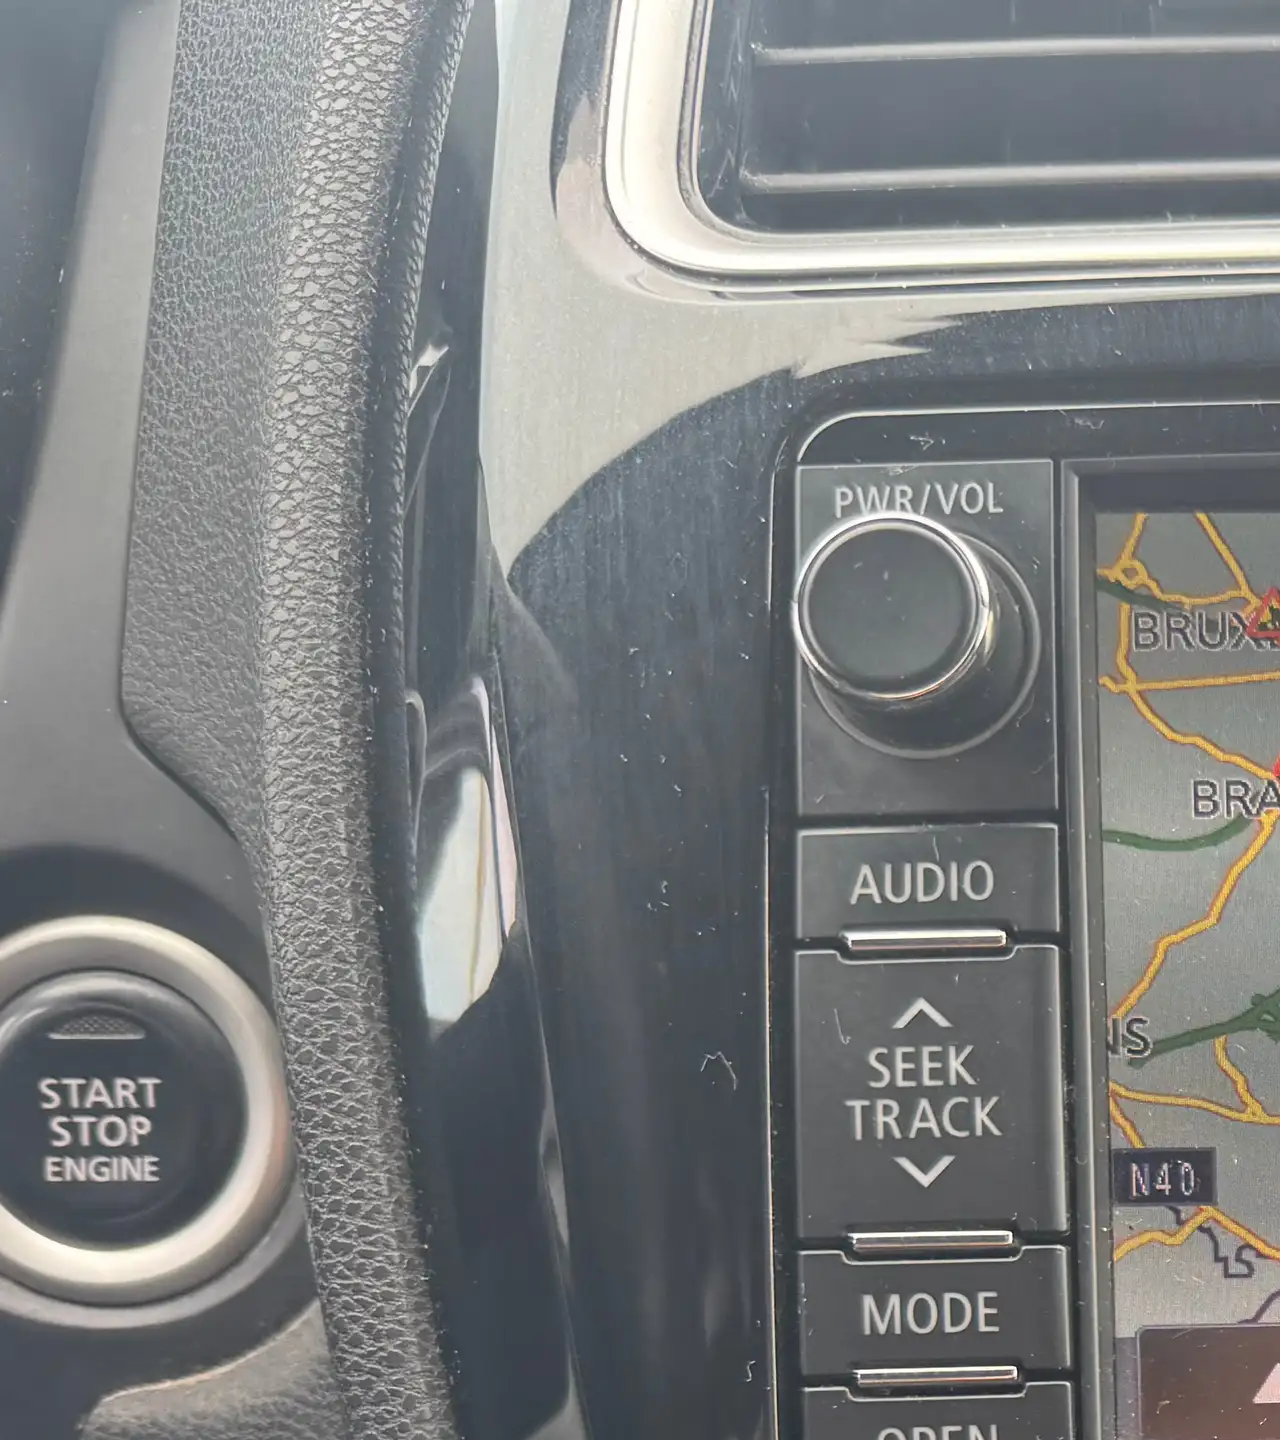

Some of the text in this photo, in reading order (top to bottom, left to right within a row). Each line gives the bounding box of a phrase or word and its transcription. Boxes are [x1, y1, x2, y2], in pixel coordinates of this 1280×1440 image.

[833, 481, 1004, 518] PWR/VOL
[850, 861, 994, 905] AUDIO
[868, 1045, 978, 1089] SEEK
[38, 1077, 162, 1110] START
[49, 1115, 152, 1148] STOP
[846, 1096, 1002, 1140] TRACK
[44, 1156, 161, 1183] ENGINE
[1129, 1160, 1196, 1198] N40
[861, 1291, 1000, 1336] MODE
